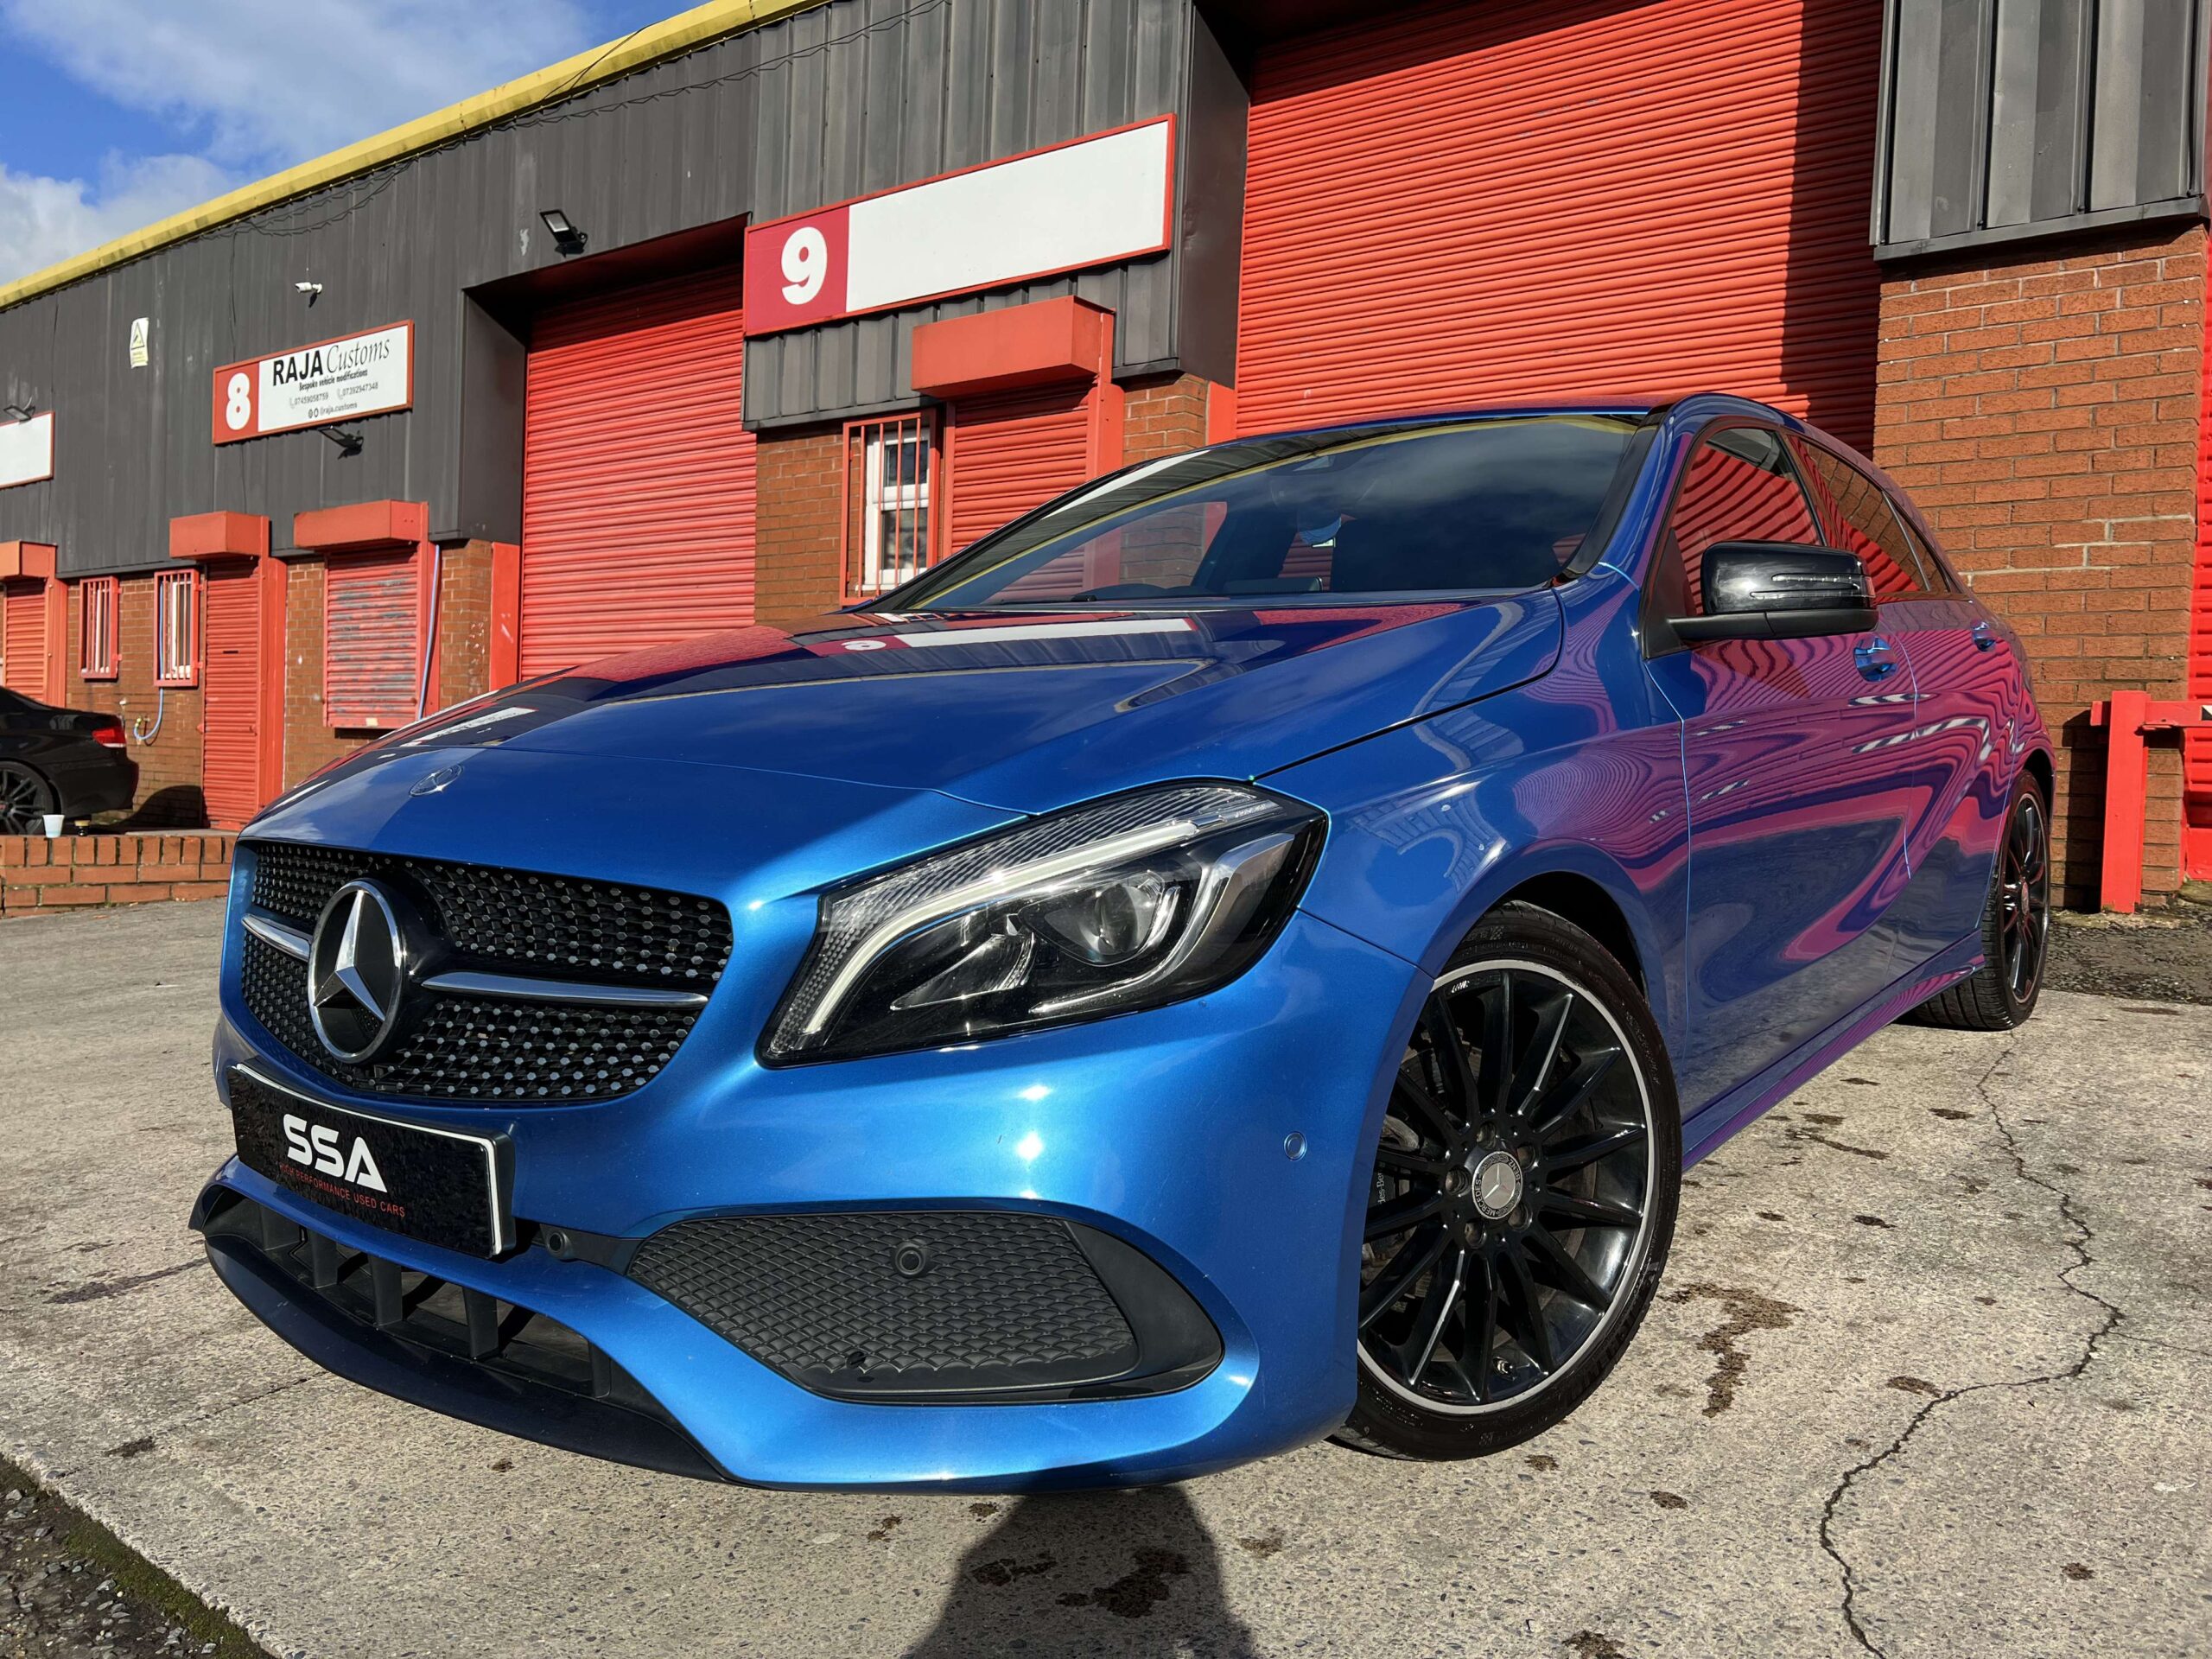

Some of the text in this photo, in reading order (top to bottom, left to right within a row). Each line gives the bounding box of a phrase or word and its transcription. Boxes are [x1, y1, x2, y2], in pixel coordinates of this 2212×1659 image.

[781, 226, 828, 305] 9
[273, 338, 390, 386] RAJA Customs
[319, 375, 335, 387] vehicle
[226, 372, 251, 431] 8
[283, 1114, 388, 1192] SSA
[1509, 1159, 1521, 1180] BENZ
[296, 1170, 351, 1200] PERFORMANCE
[353, 1193, 377, 1209] USED
[380, 1201, 405, 1217] CARS
[1475, 1179, 1496, 1216] MERCEDES
